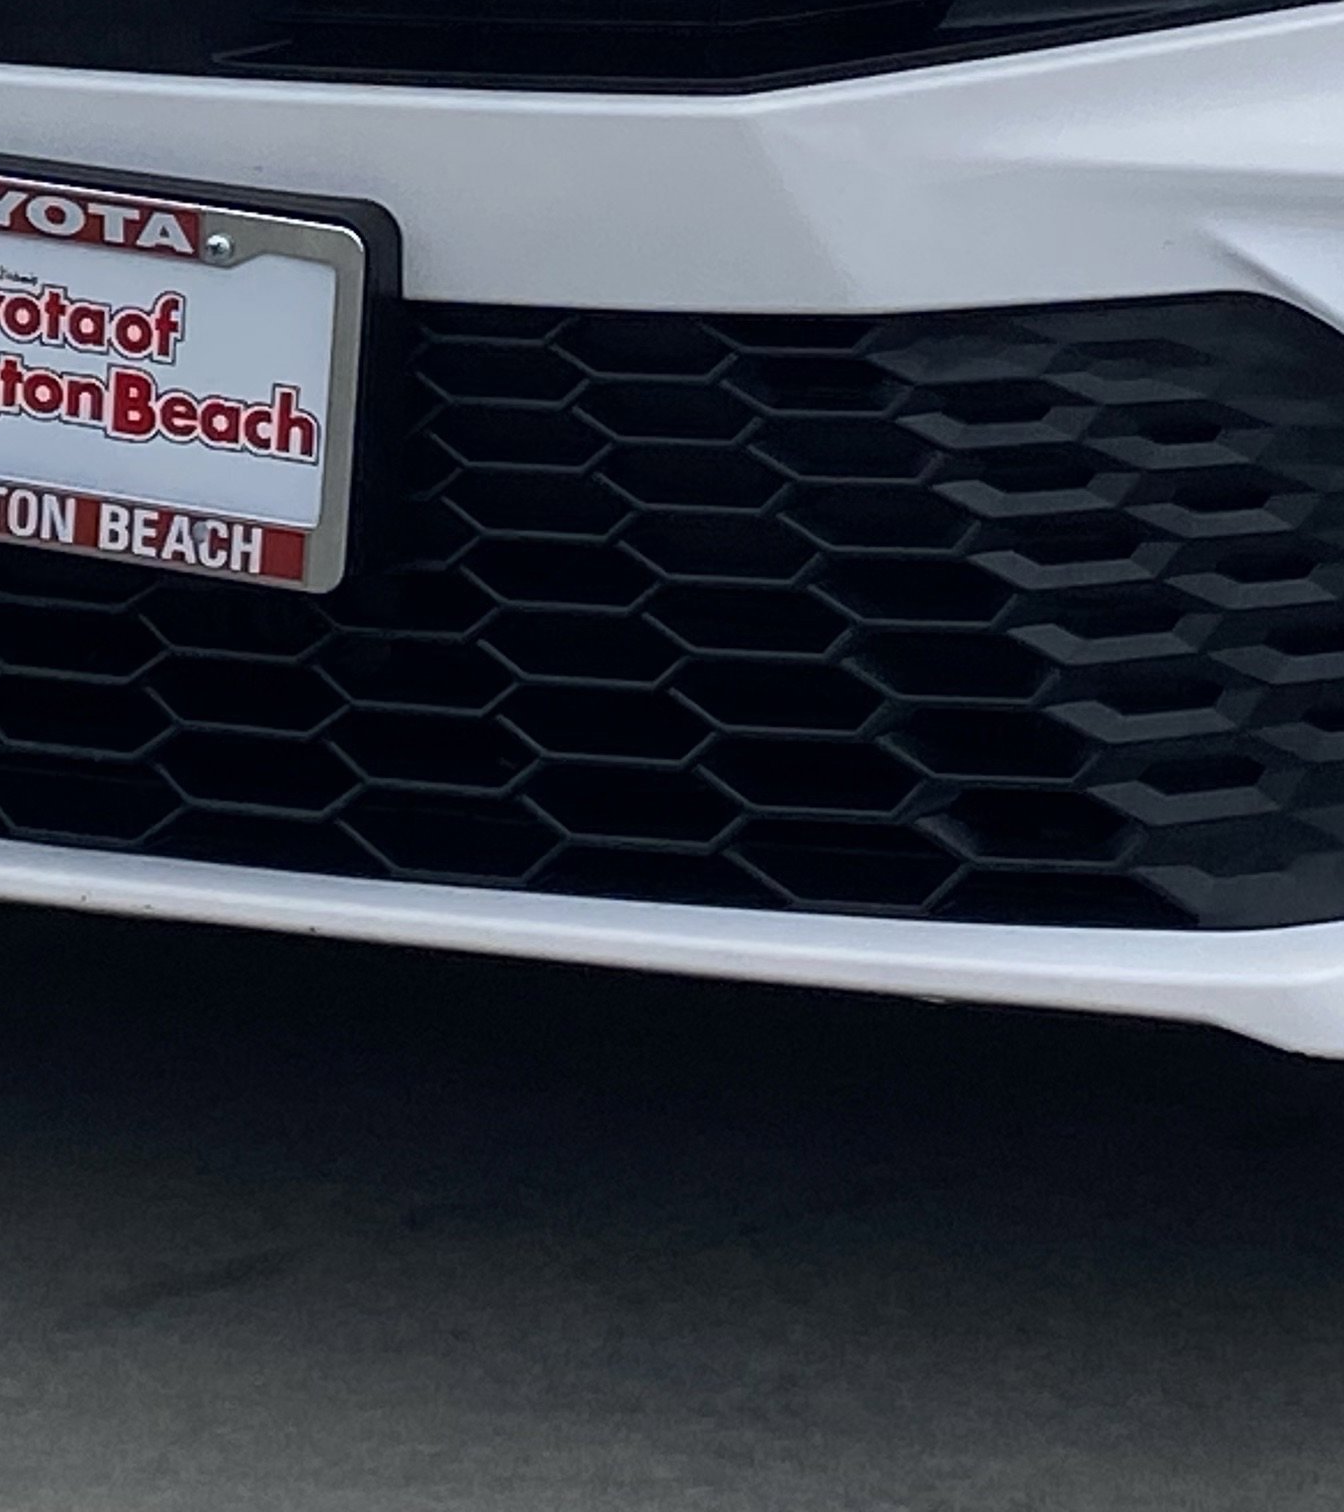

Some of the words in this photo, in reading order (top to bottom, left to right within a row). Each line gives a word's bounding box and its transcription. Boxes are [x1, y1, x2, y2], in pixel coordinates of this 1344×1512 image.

[114, 294, 182, 356] of
[111, 370, 315, 457] Beach
[98, 502, 264, 574] BEACH
